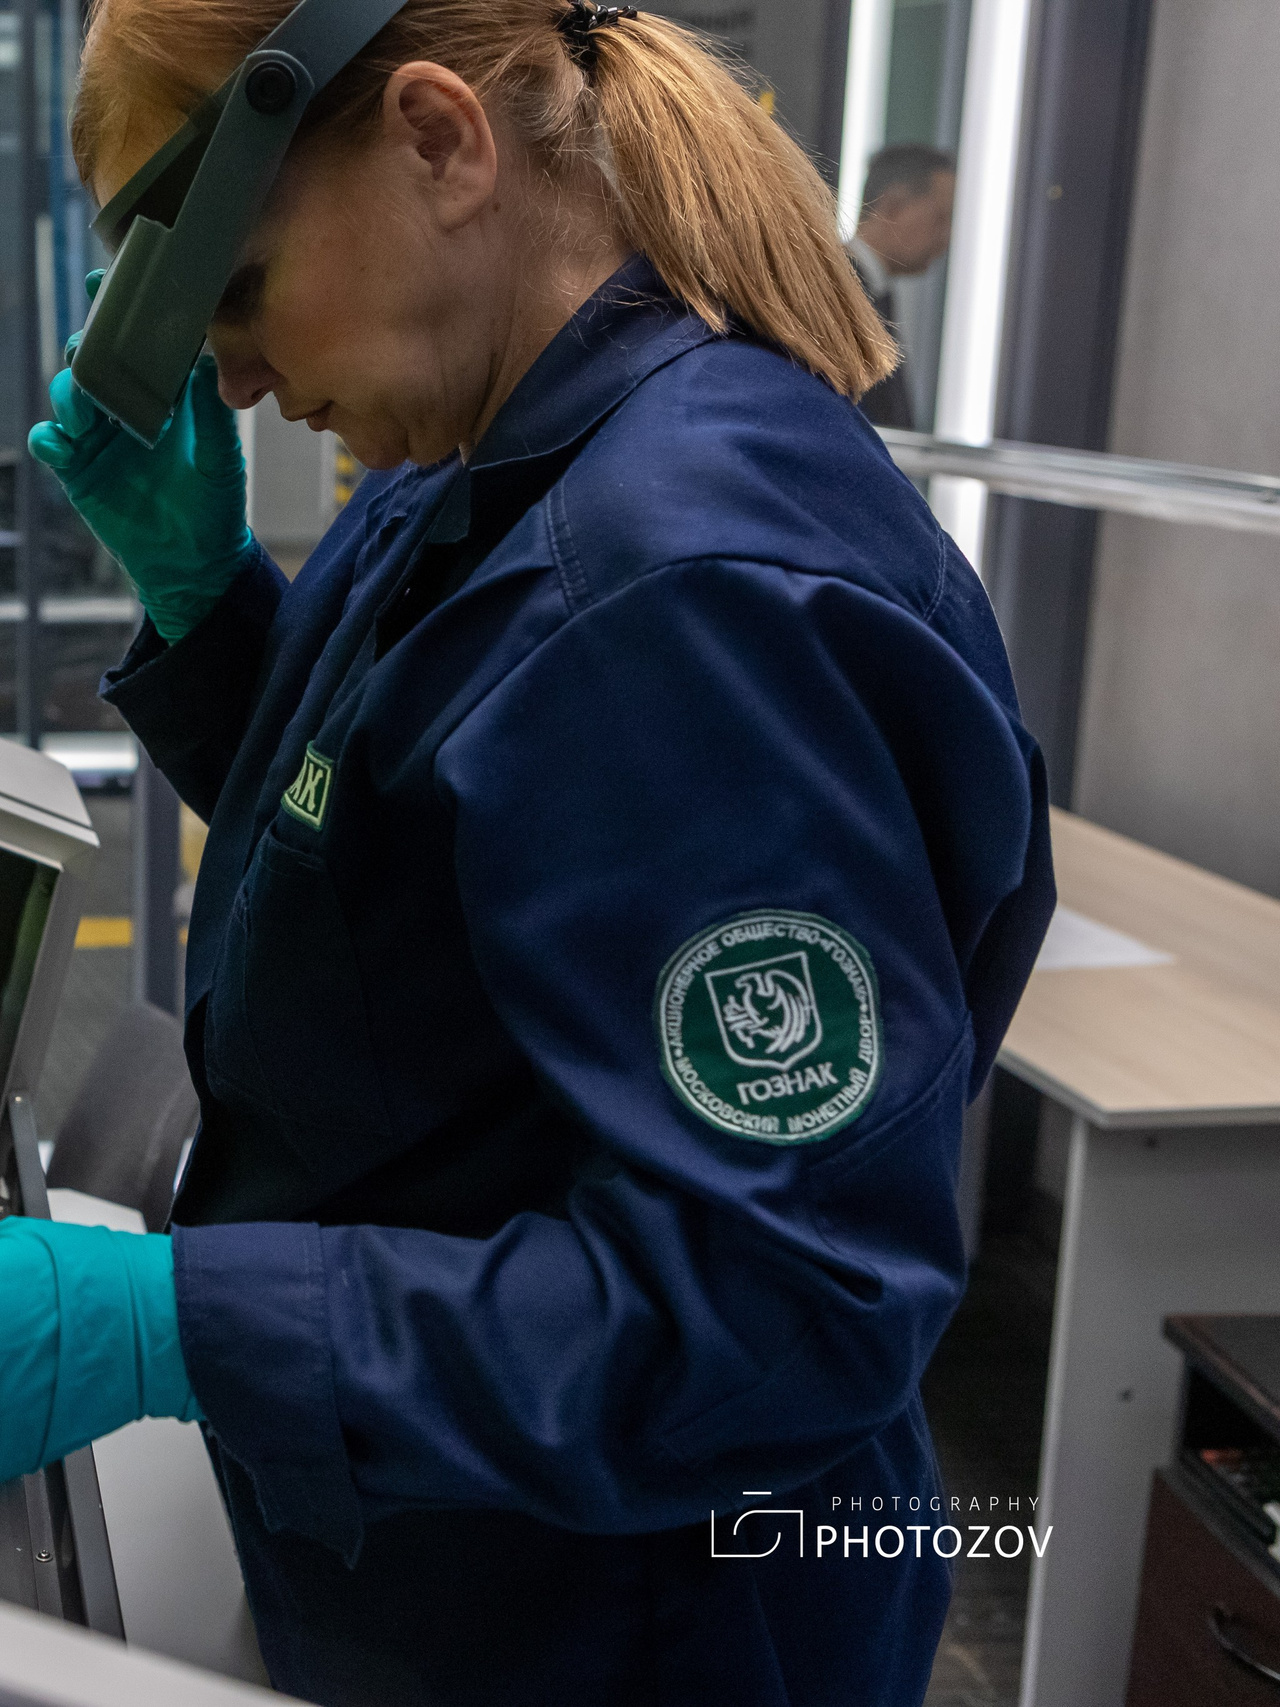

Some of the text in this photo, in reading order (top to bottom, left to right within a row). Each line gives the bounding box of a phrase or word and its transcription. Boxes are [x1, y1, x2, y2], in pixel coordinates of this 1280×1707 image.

[289, 756, 323, 812] АК
[665, 940, 723, 1052] АКЦИОНЕРНОЕ
[722, 922, 819, 947] ОБЩЕСТВО
[675, 1011, 875, 1134] МОСКОВСКИЙ МОНЕТНЫЙ ДВОР
[736, 1062, 839, 1105] ГОЗНАК
